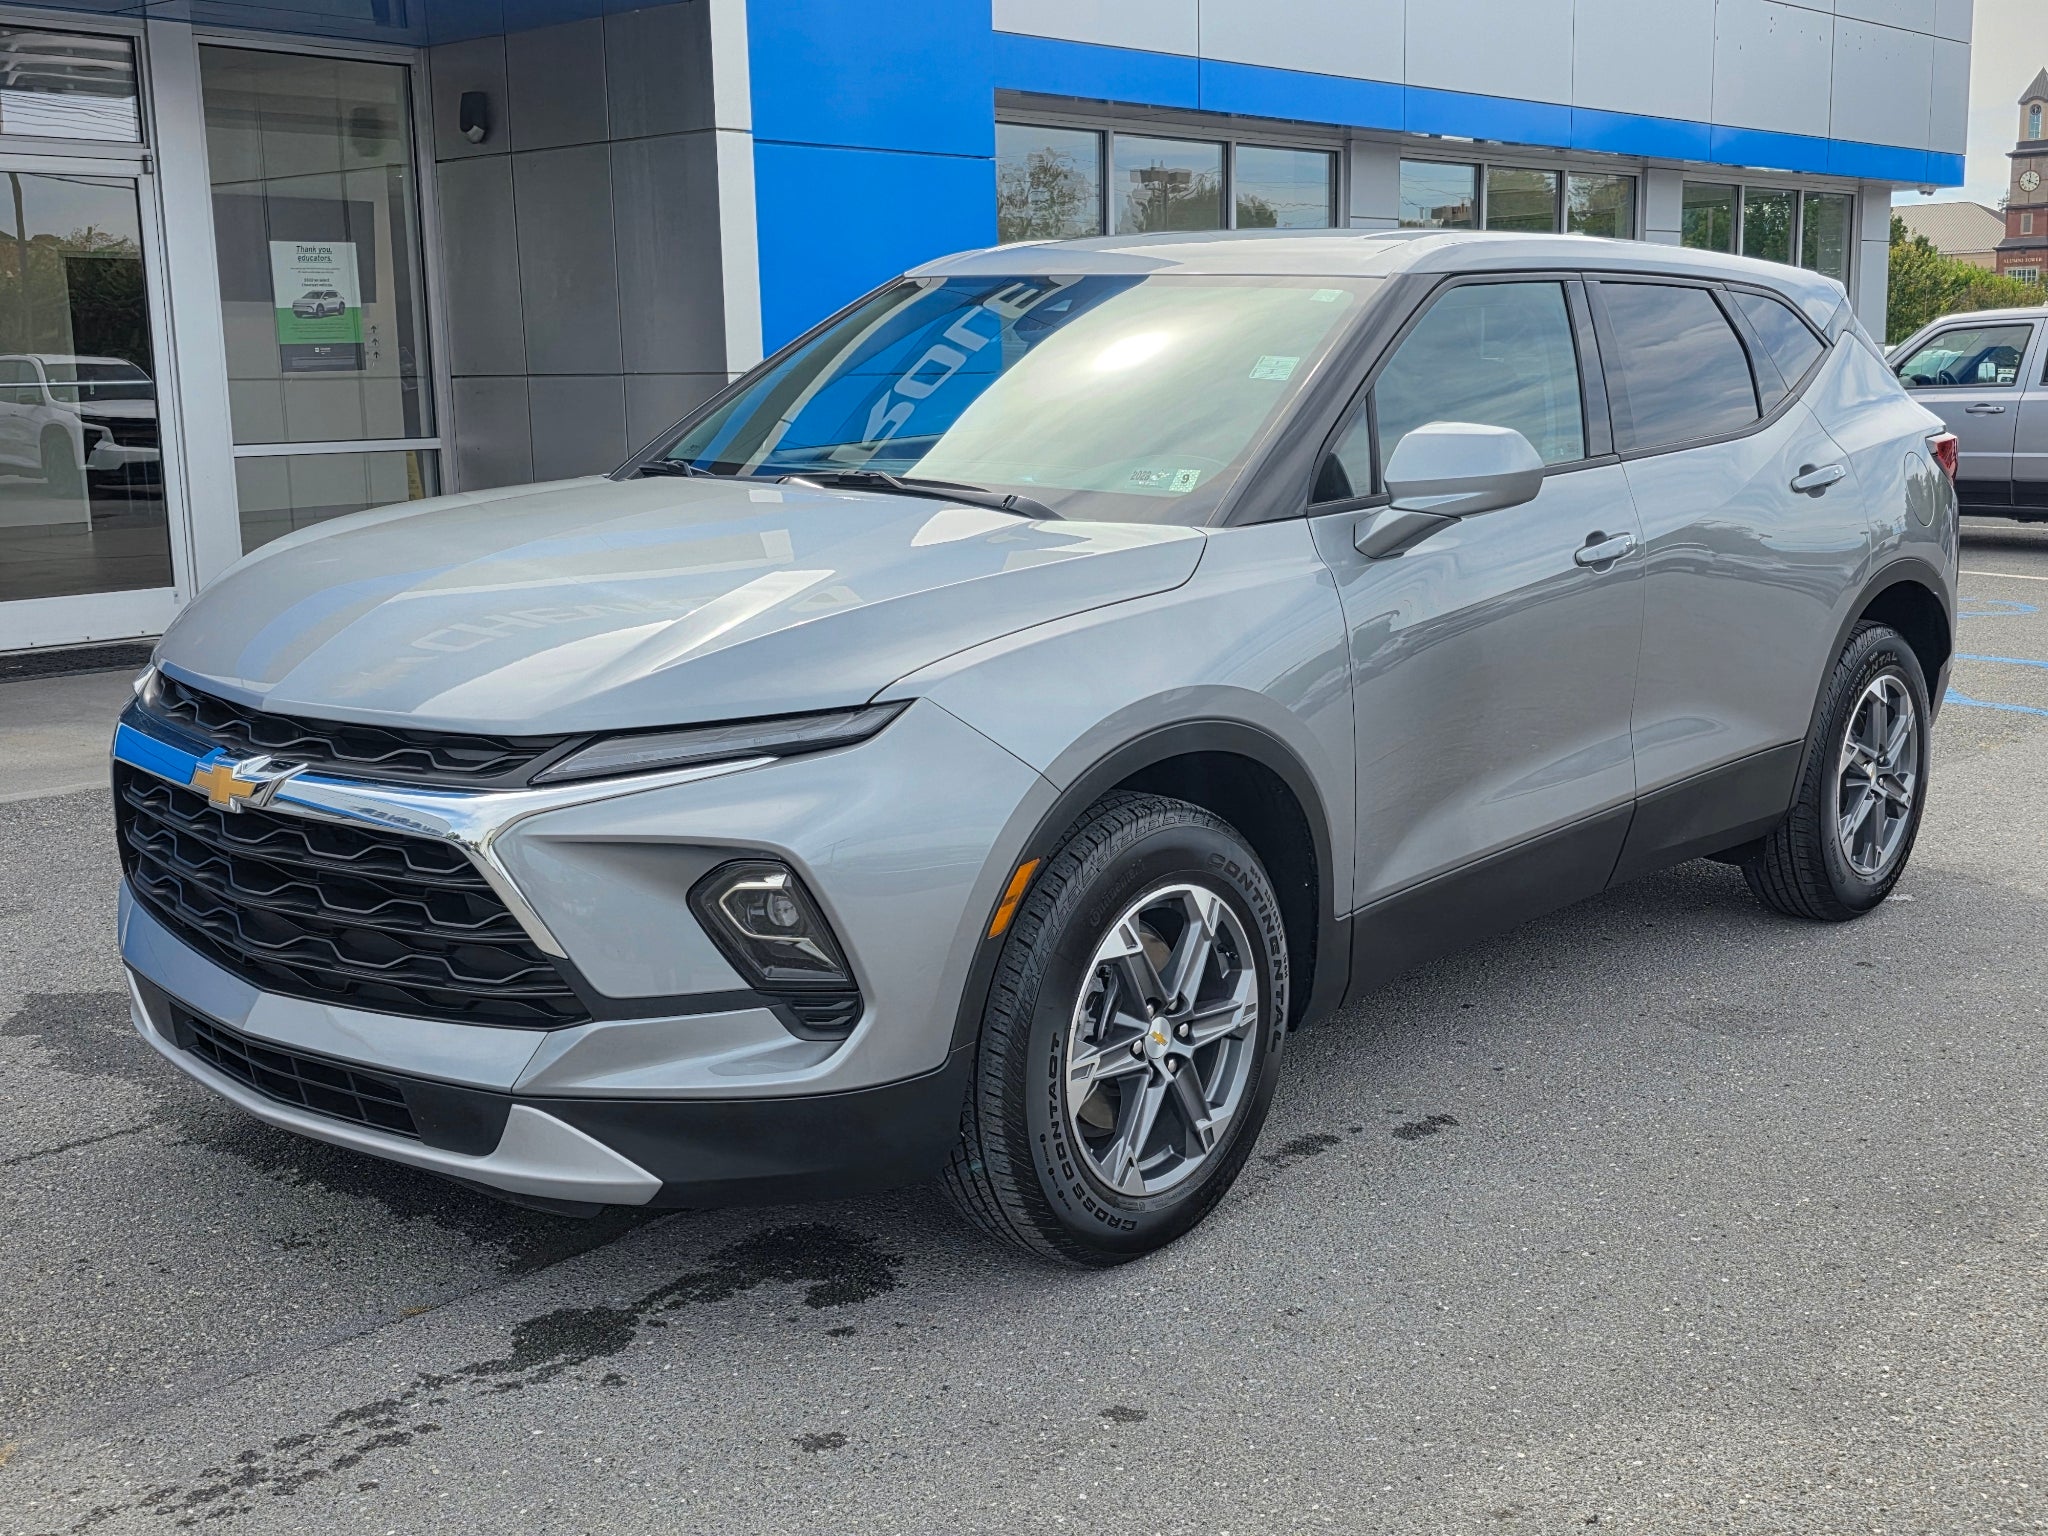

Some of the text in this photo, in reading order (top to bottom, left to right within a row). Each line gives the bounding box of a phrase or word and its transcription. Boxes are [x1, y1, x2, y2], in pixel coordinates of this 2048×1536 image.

[296, 245, 317, 253] Thank
[1180, 473, 1191, 484] 9
[1207, 852, 1285, 1052] CONTINENTAL
